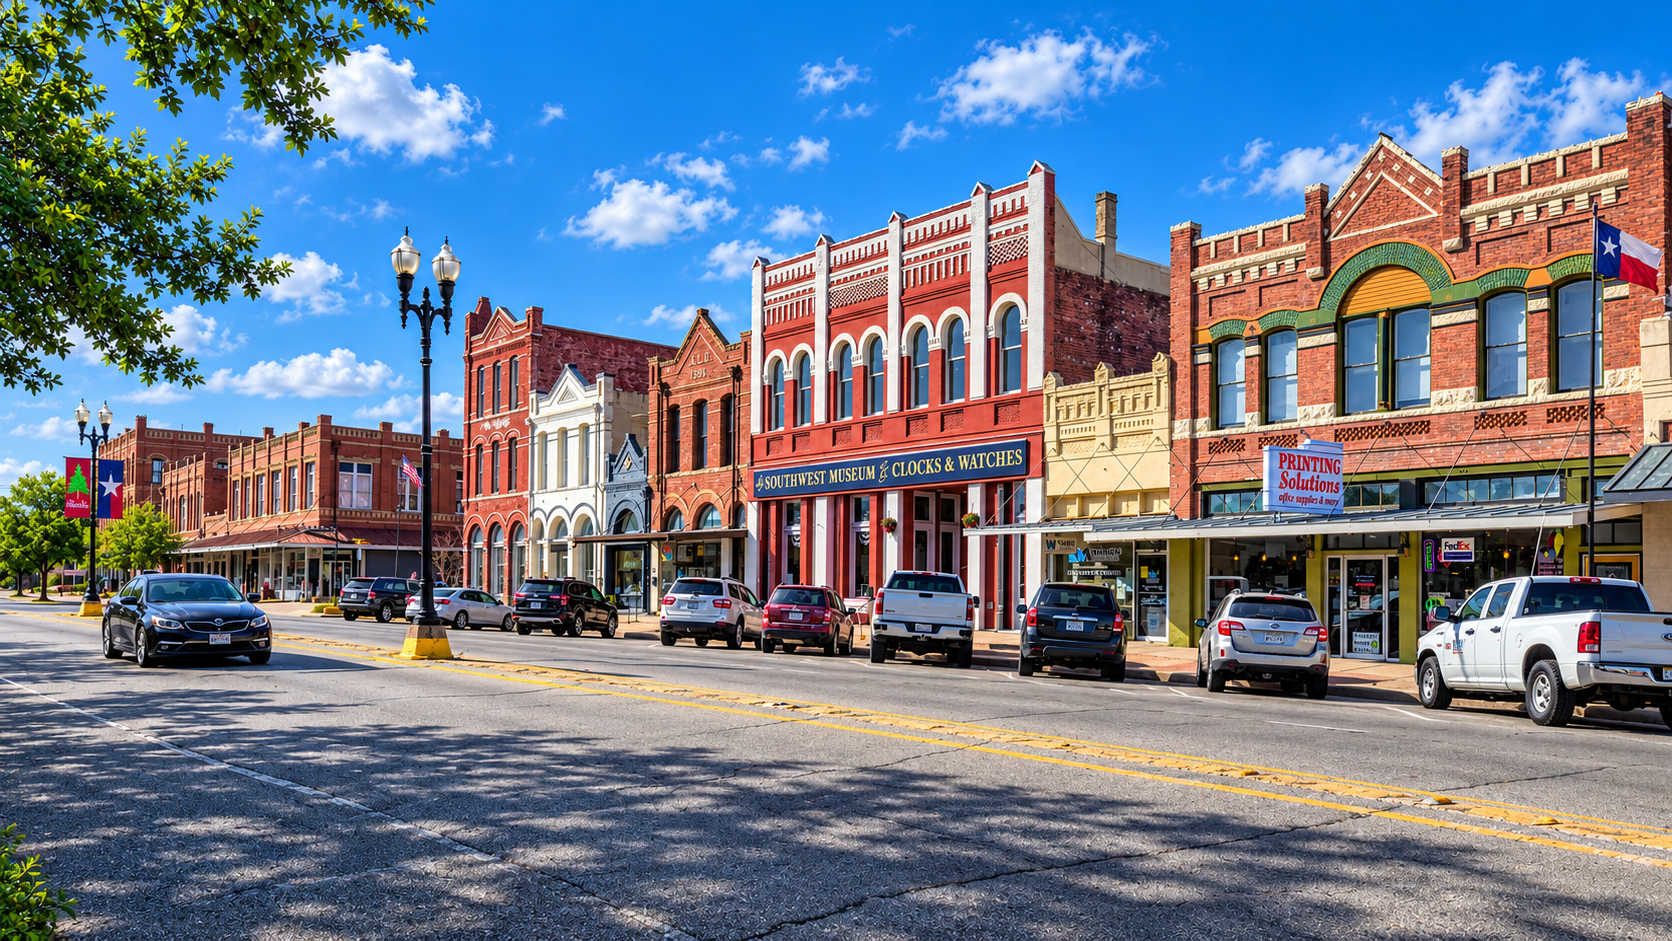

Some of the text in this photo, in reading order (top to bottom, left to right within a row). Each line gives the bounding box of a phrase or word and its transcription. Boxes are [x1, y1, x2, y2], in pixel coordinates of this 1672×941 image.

[765, 470, 827, 490] SOUTHWEST
[829, 465, 876, 485] MUSEUM
[892, 457, 942, 478] CLOCKS
[945, 456, 955, 472] &
[958, 448, 1023, 470] WATCHES
[1278, 452, 1341, 475] PRINTING
[1278, 470, 1340, 494] Solutions
[1444, 540, 1471, 550] FedEx
